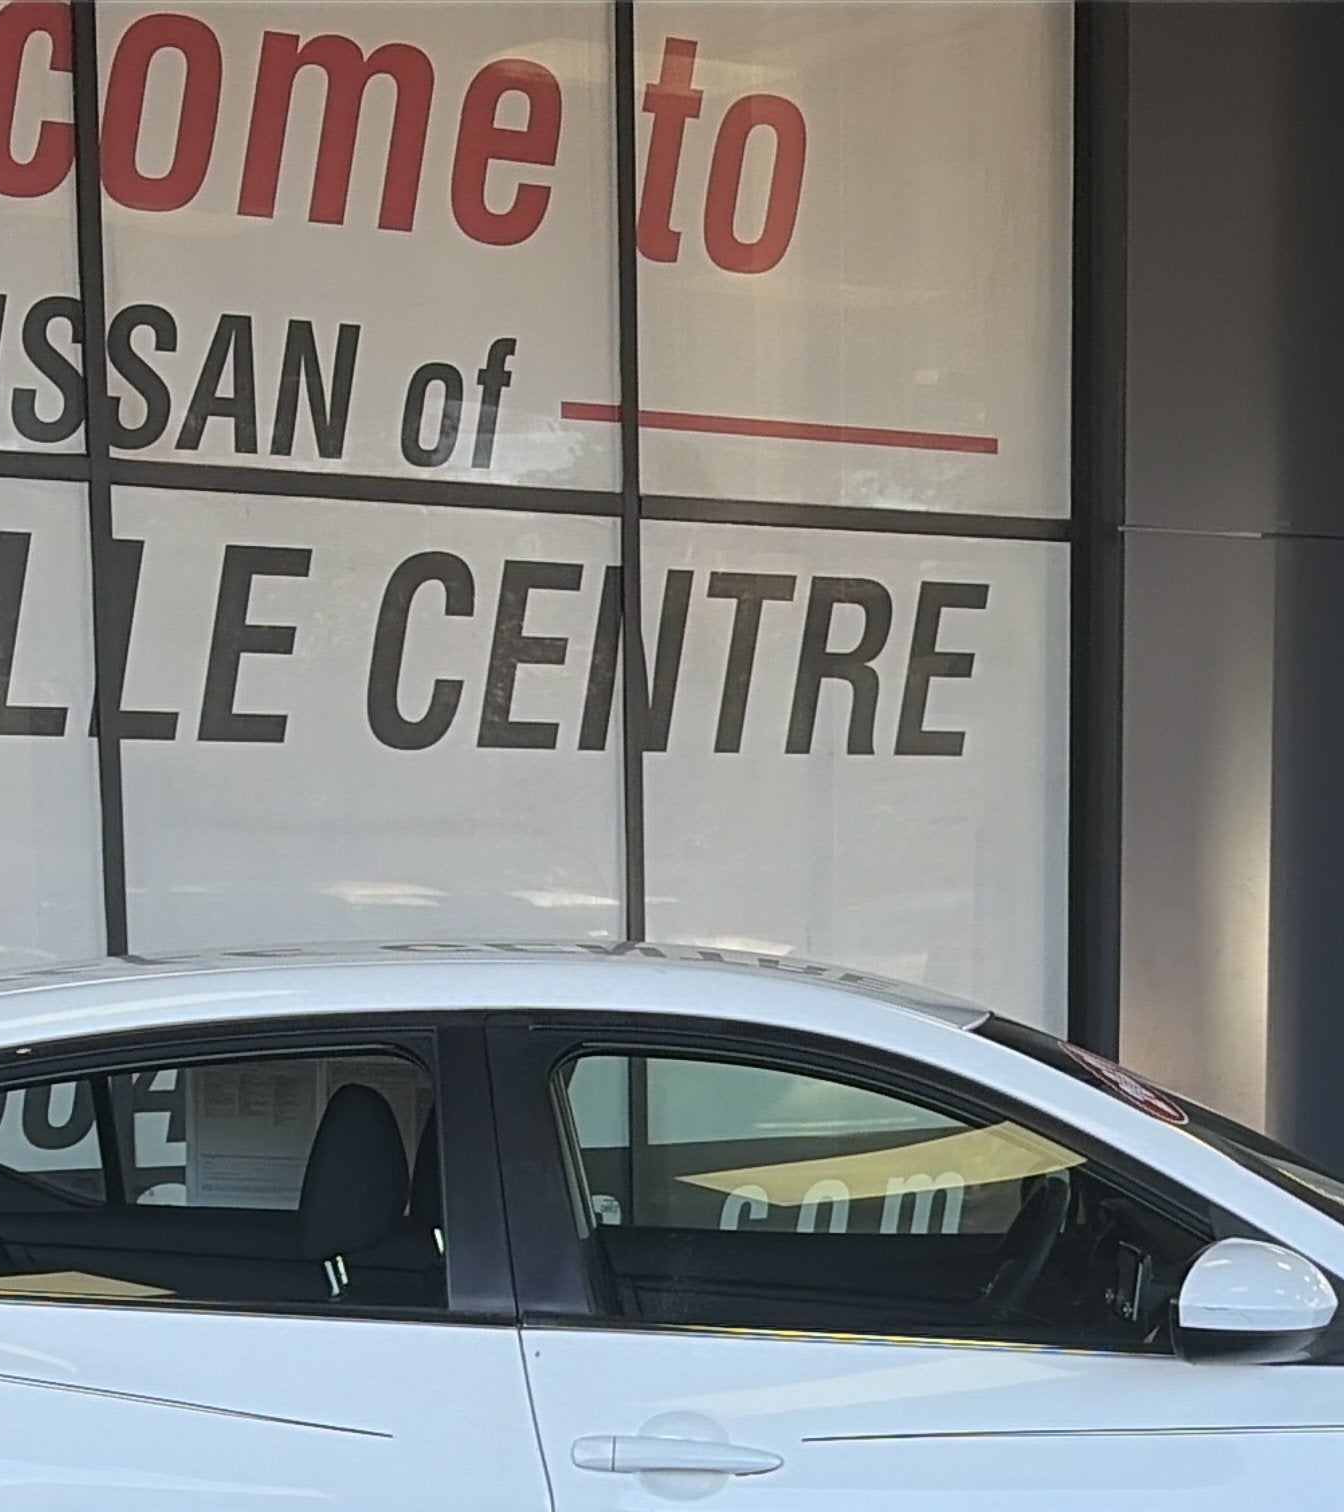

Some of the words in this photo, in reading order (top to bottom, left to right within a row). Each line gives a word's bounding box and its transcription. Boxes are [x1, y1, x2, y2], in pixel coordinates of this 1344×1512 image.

[634, 37, 807, 274] to
[400, 338, 517, 469] of
[367, 551, 990, 757] CENTRE
